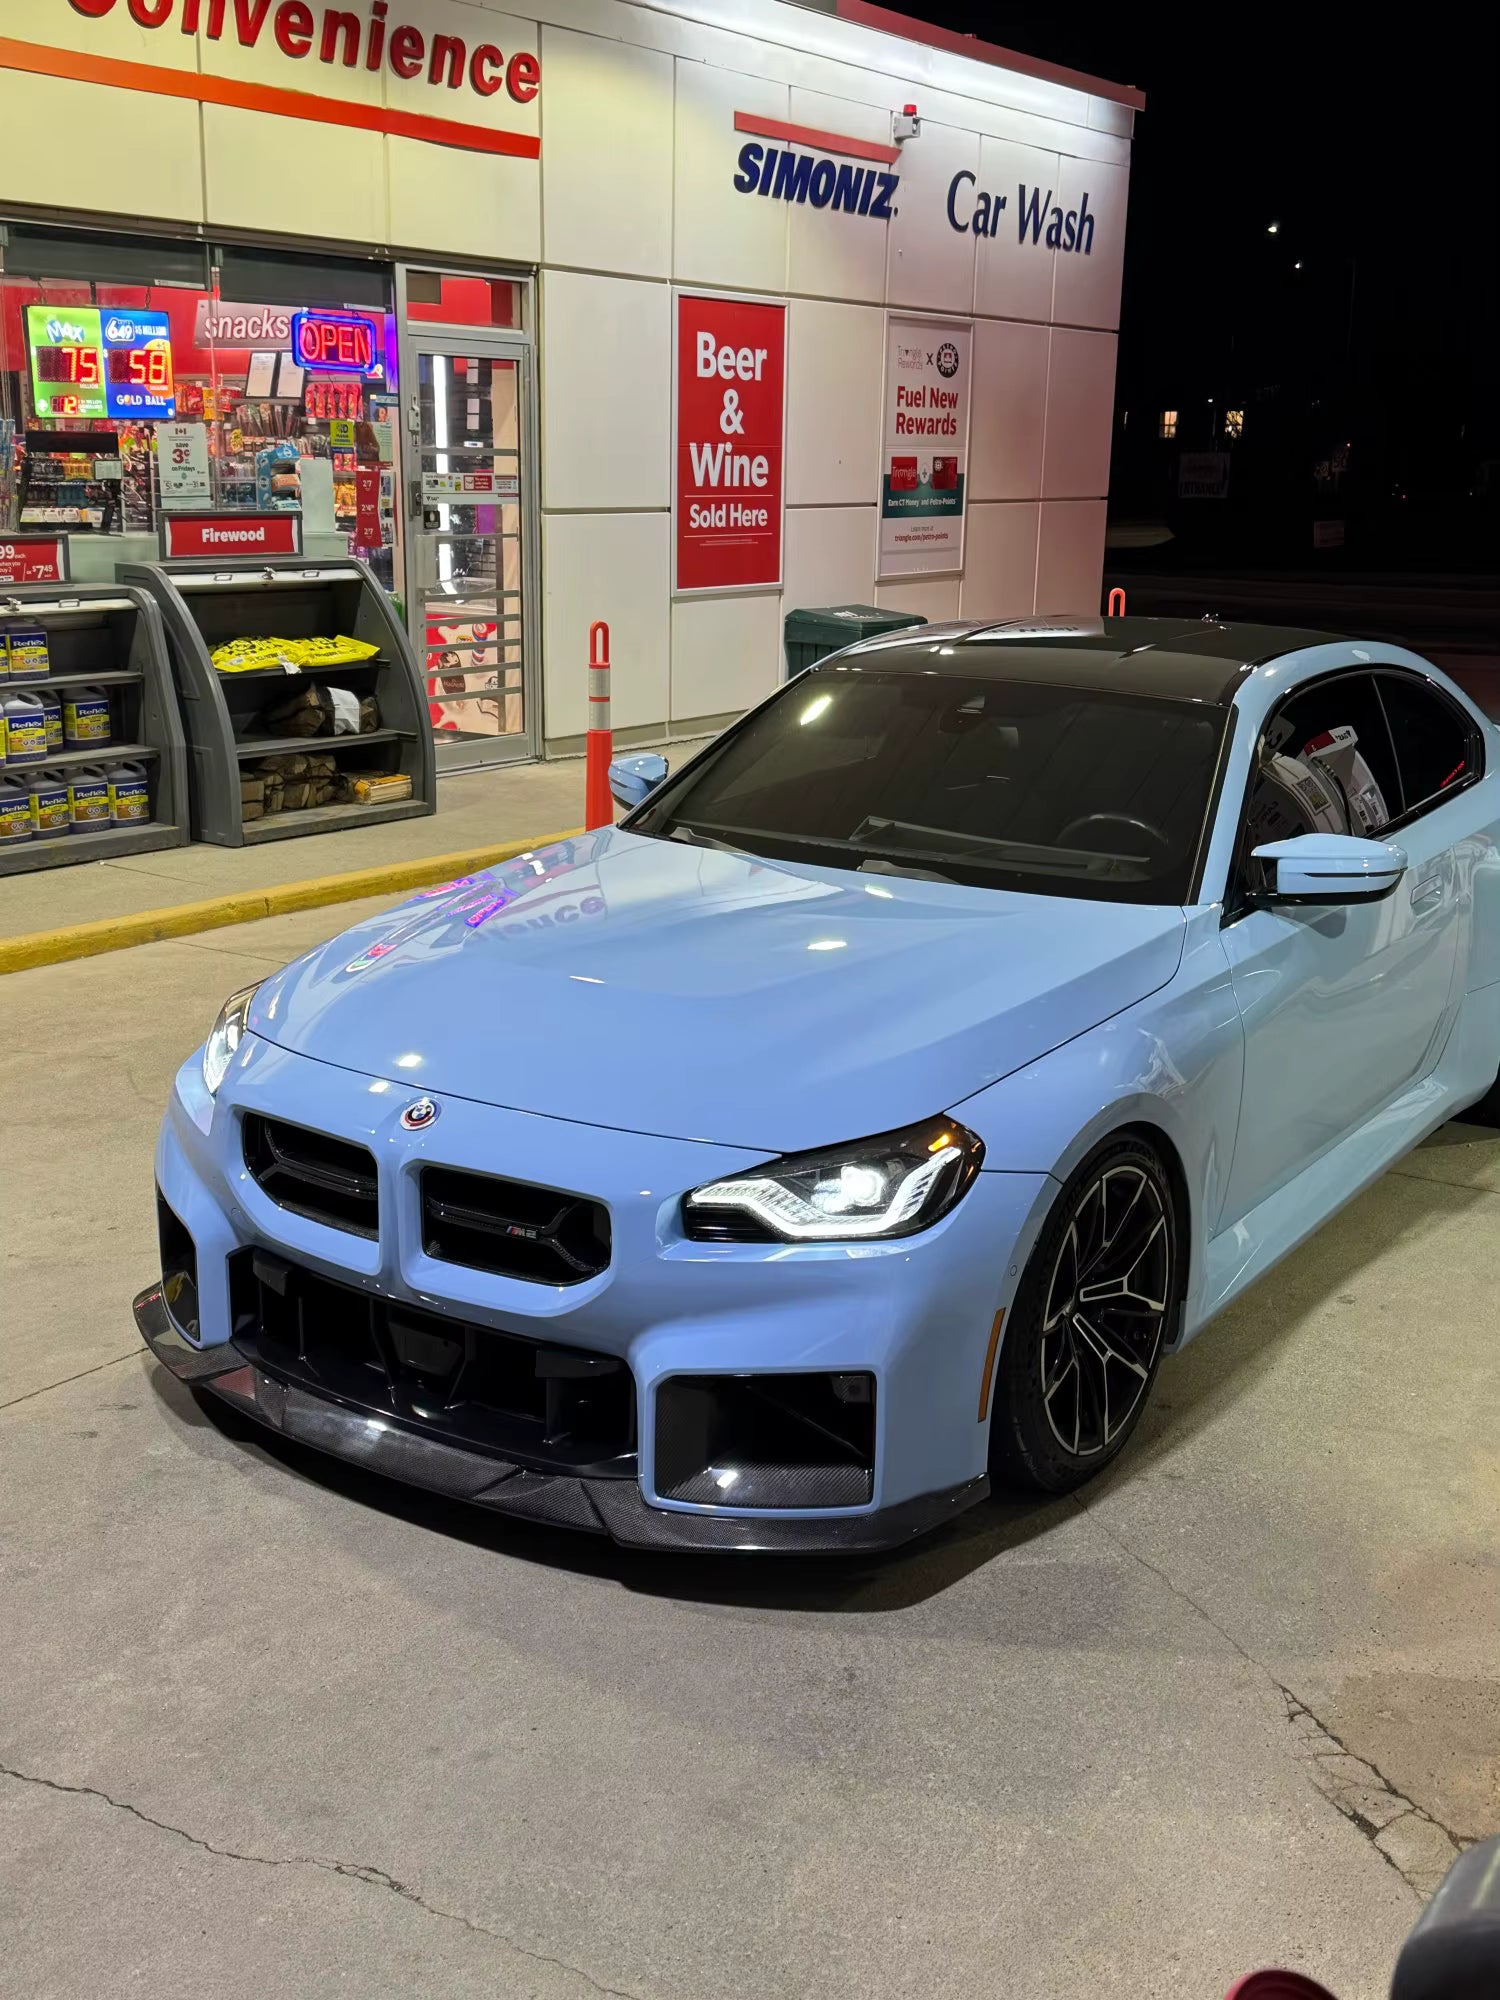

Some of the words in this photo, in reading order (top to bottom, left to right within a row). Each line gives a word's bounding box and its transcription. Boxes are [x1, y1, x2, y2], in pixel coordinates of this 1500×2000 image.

[67, 0, 541, 104] onvenience
[947, 170, 1007, 239] Car
[1018, 183, 1095, 256] Wash
[204, 308, 289, 340] snacks
[301, 321, 372, 365] OPEN
[62, 347, 97, 381] 75
[130, 350, 166, 384] 58
[696, 331, 768, 382] Beer
[64, 396, 76, 414] 12
[116, 394, 143, 406] GOLD
[145, 395, 167, 406] BALL
[897, 385, 926, 408] Fuel
[930, 387, 959, 409] New
[719, 388, 744, 435] &
[896, 412, 957, 436] Rewards
[178, 465, 196, 473] Fridays
[689, 442, 769, 488] Wine
[690, 503, 727, 529] Sold
[730, 503, 769, 527] Here
[202, 526, 265, 543] Firewood
[79, 707, 107, 716] Reflex
[11, 721, 42, 729] Reflex
[41, 797, 67, 806] Reflex
[76, 789, 106, 799] Reflex
[118, 788, 147, 796] Reflex
[1, 804, 29, 813] Reflex
